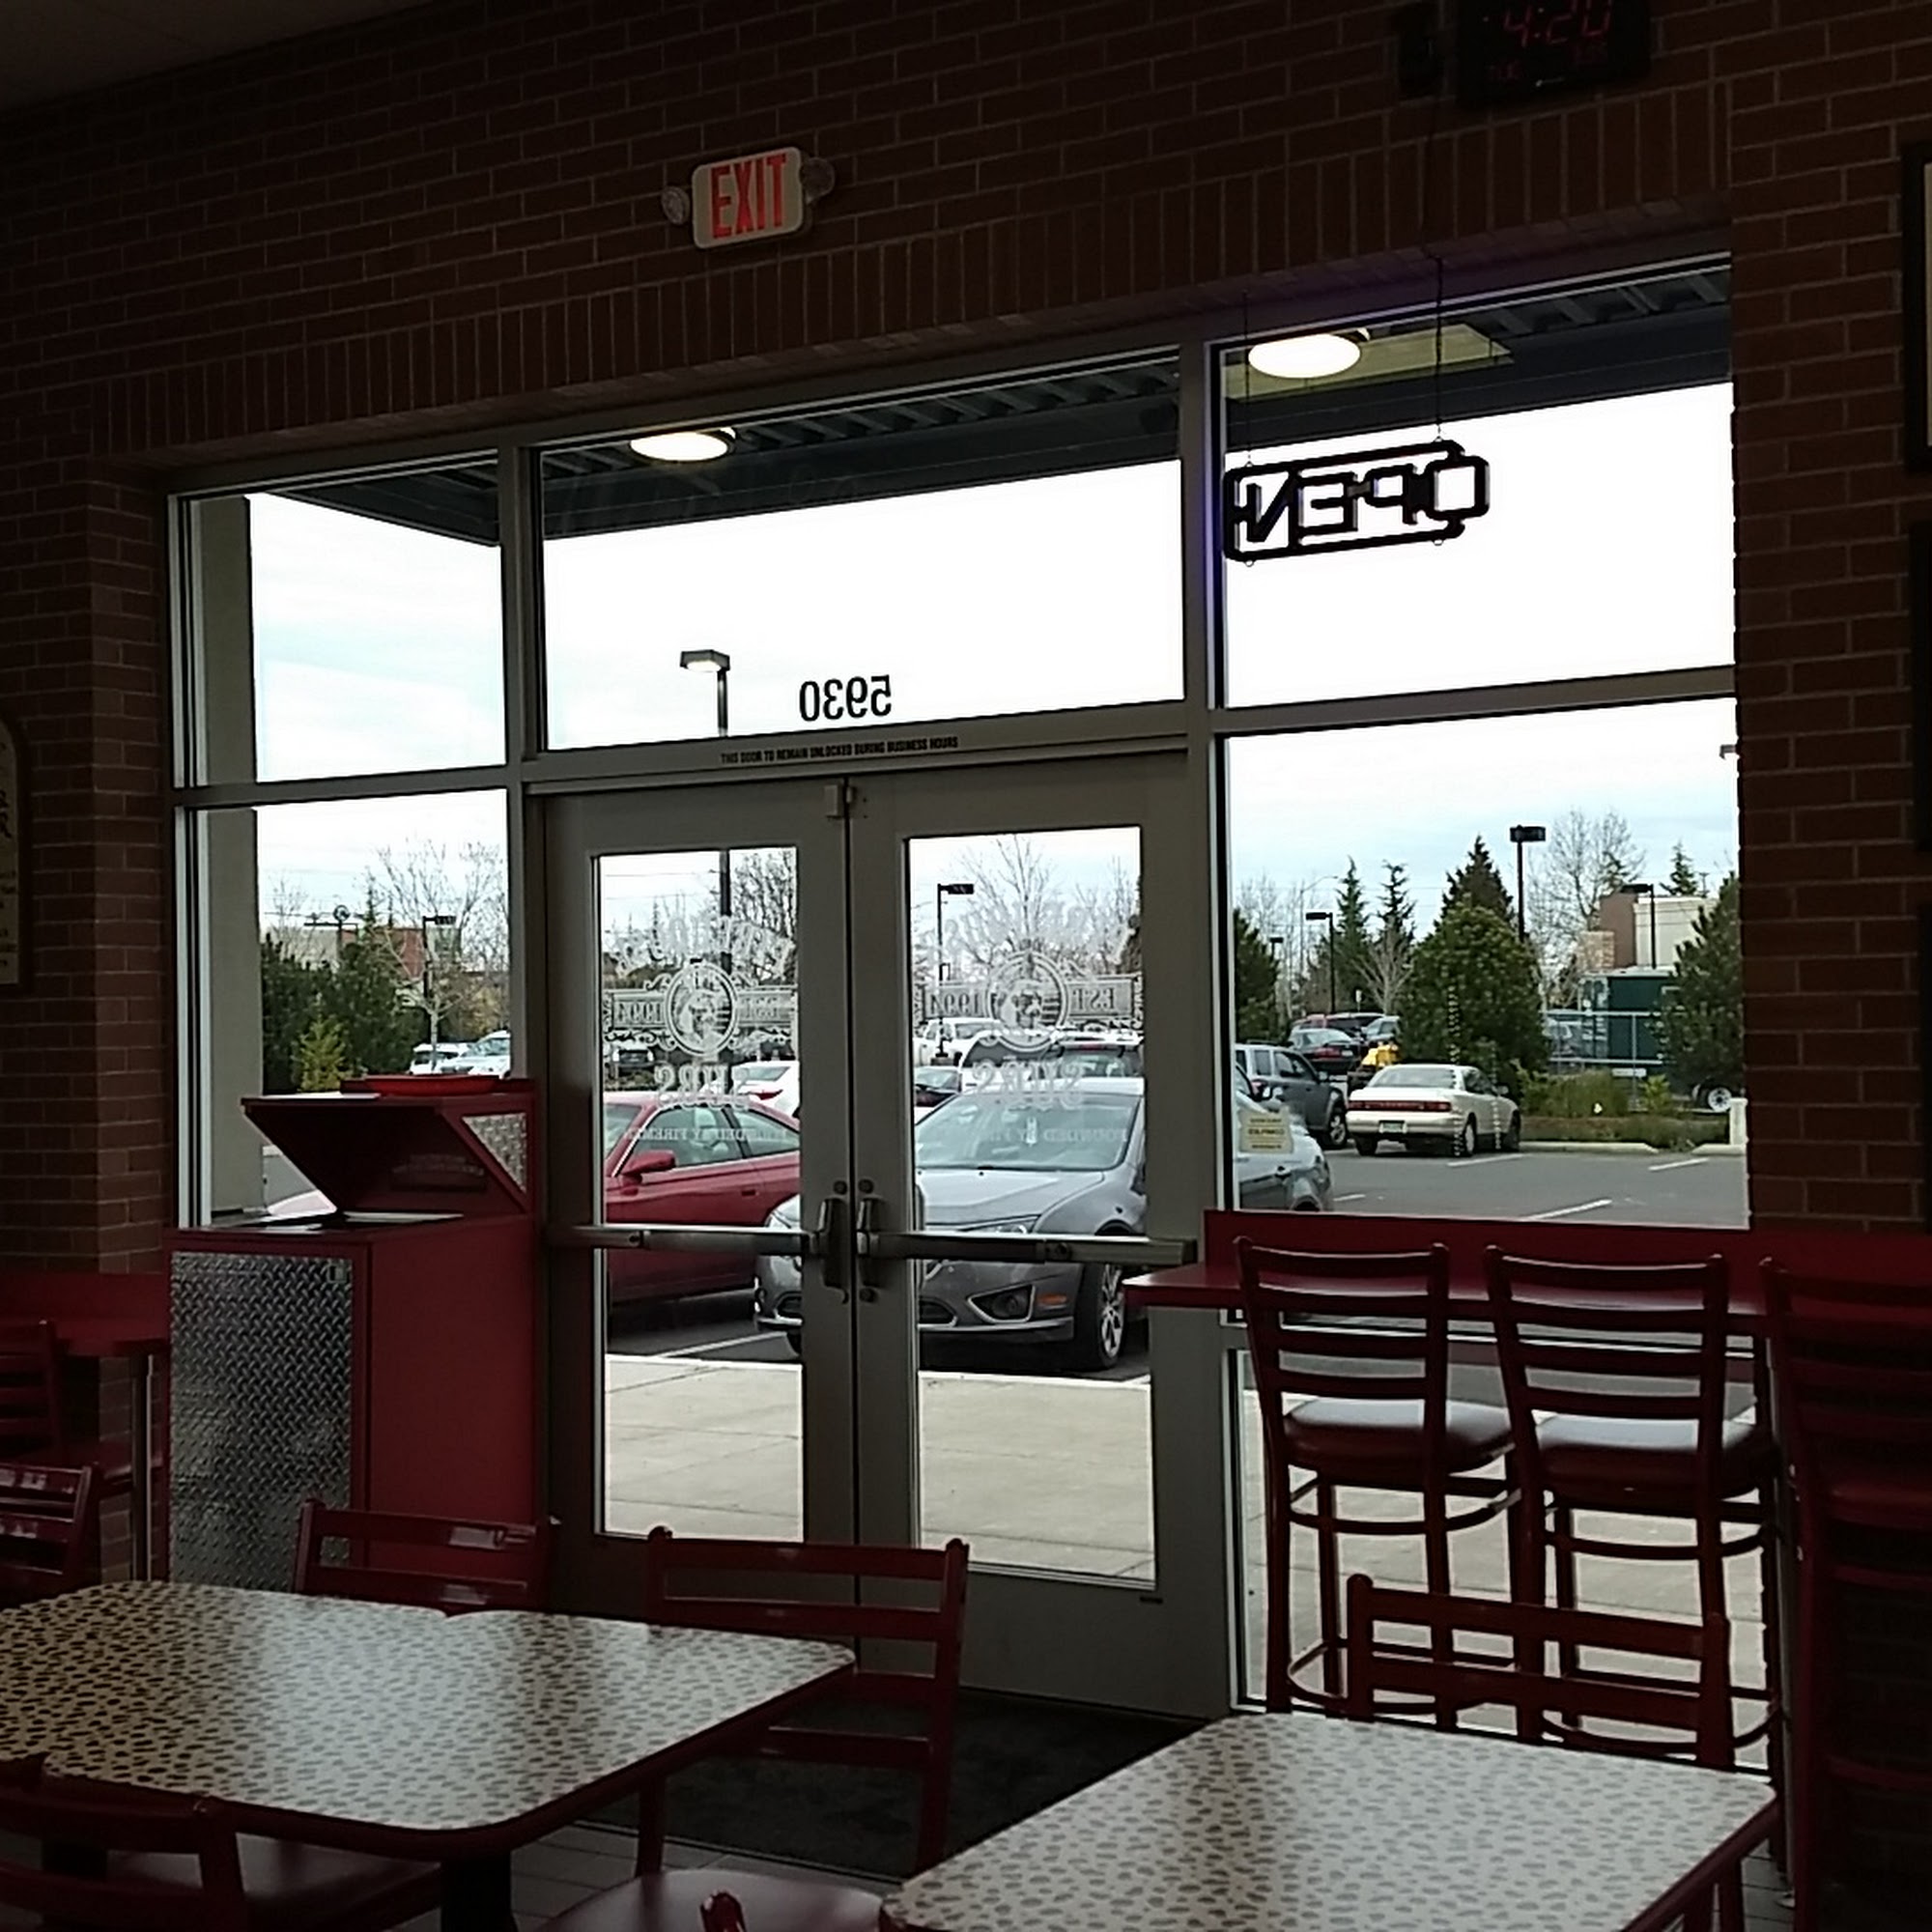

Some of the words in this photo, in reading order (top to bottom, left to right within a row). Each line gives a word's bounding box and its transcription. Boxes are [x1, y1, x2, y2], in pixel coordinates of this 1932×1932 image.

[1504, 0, 1613, 48] 4:20
[711, 153, 787, 240] EXIT
[721, 752, 739, 764] THIS
[740, 750, 762, 763] DOOR
[763, 749, 775, 762] TO
[776, 747, 808, 761] REMAIN
[810, 743, 852, 759] UNLOCKED
[854, 741, 885, 755] DURING
[887, 738, 928, 754] BUSINESS
[929, 735, 958, 750] HOURS
